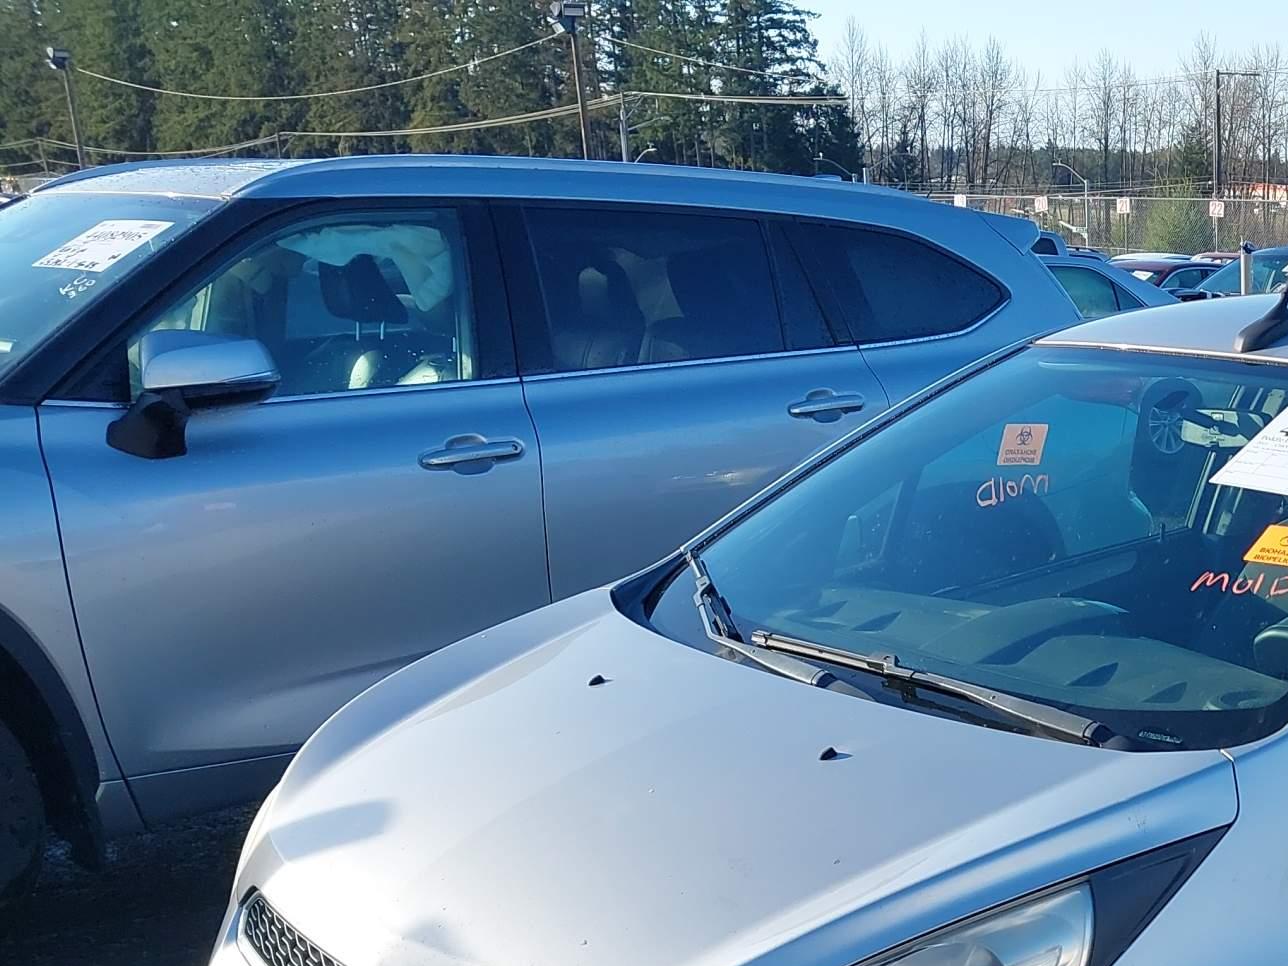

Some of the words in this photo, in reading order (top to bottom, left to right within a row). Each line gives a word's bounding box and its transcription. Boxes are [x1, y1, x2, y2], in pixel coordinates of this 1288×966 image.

[1035, 199, 1047, 211] 20
[1118, 200, 1129, 212] 21
[1210, 203, 1223, 216] 22
